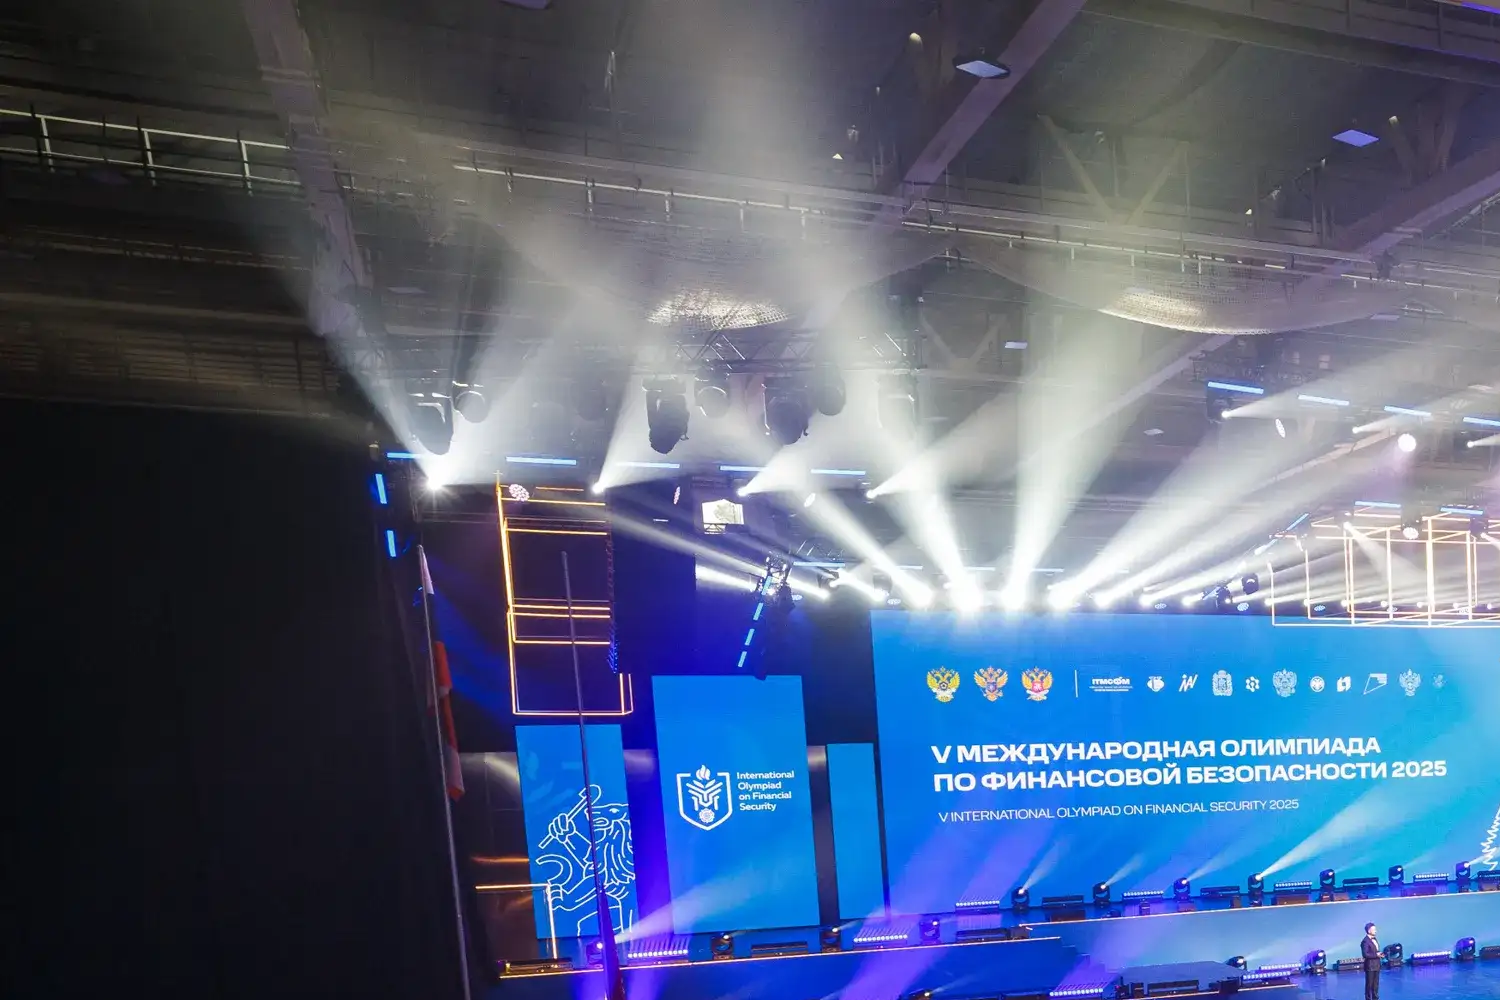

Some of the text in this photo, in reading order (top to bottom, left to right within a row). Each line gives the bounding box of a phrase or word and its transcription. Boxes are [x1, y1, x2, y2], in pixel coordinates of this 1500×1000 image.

[931, 737, 1381, 765] V МЕЖДУНАРОДНАЯ ОЛИМПИАДА
[736, 770, 795, 780] International
[933, 760, 1448, 792] ПО ФИНАНСОВОЙ БЕЗОПАСНОСТИ 2025
[738, 782, 782, 791] Olympiad
[752, 791, 792, 800] Financial
[739, 802, 777, 812] Security
[938, 799, 1299, 822] V INTERNATIONAL OLYMPIAD ON FINANCIAL SECURITY 2025
